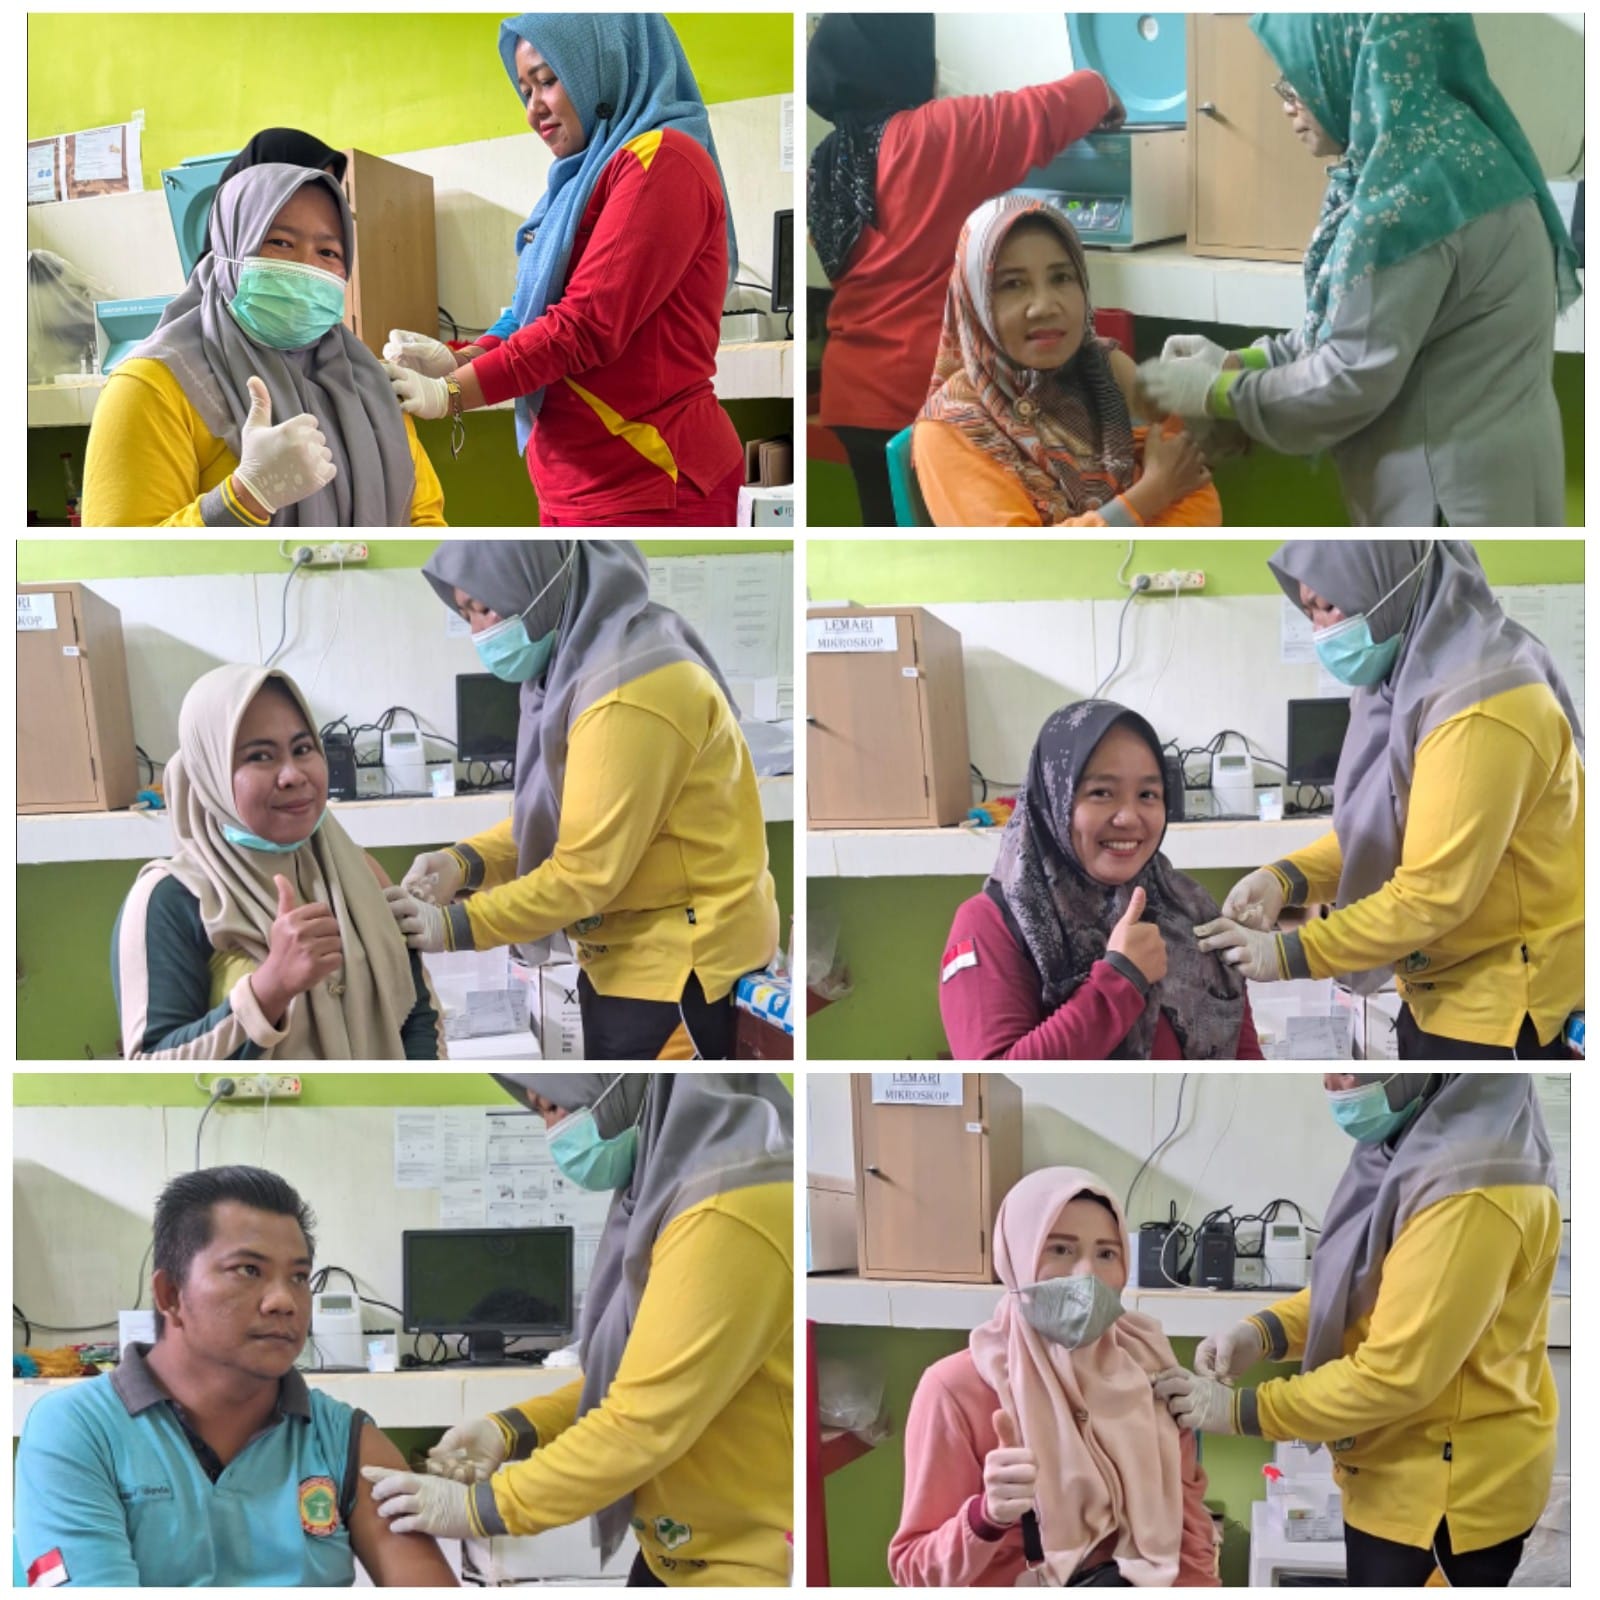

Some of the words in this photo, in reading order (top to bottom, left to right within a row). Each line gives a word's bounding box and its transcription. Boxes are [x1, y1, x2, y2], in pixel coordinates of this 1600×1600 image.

[824, 619, 873, 633] LEMARI
[817, 637, 884, 649] MIKROSKOP
[892, 1073, 941, 1085] LEMARI
[884, 1089, 949, 1101] MIKROSKOP
